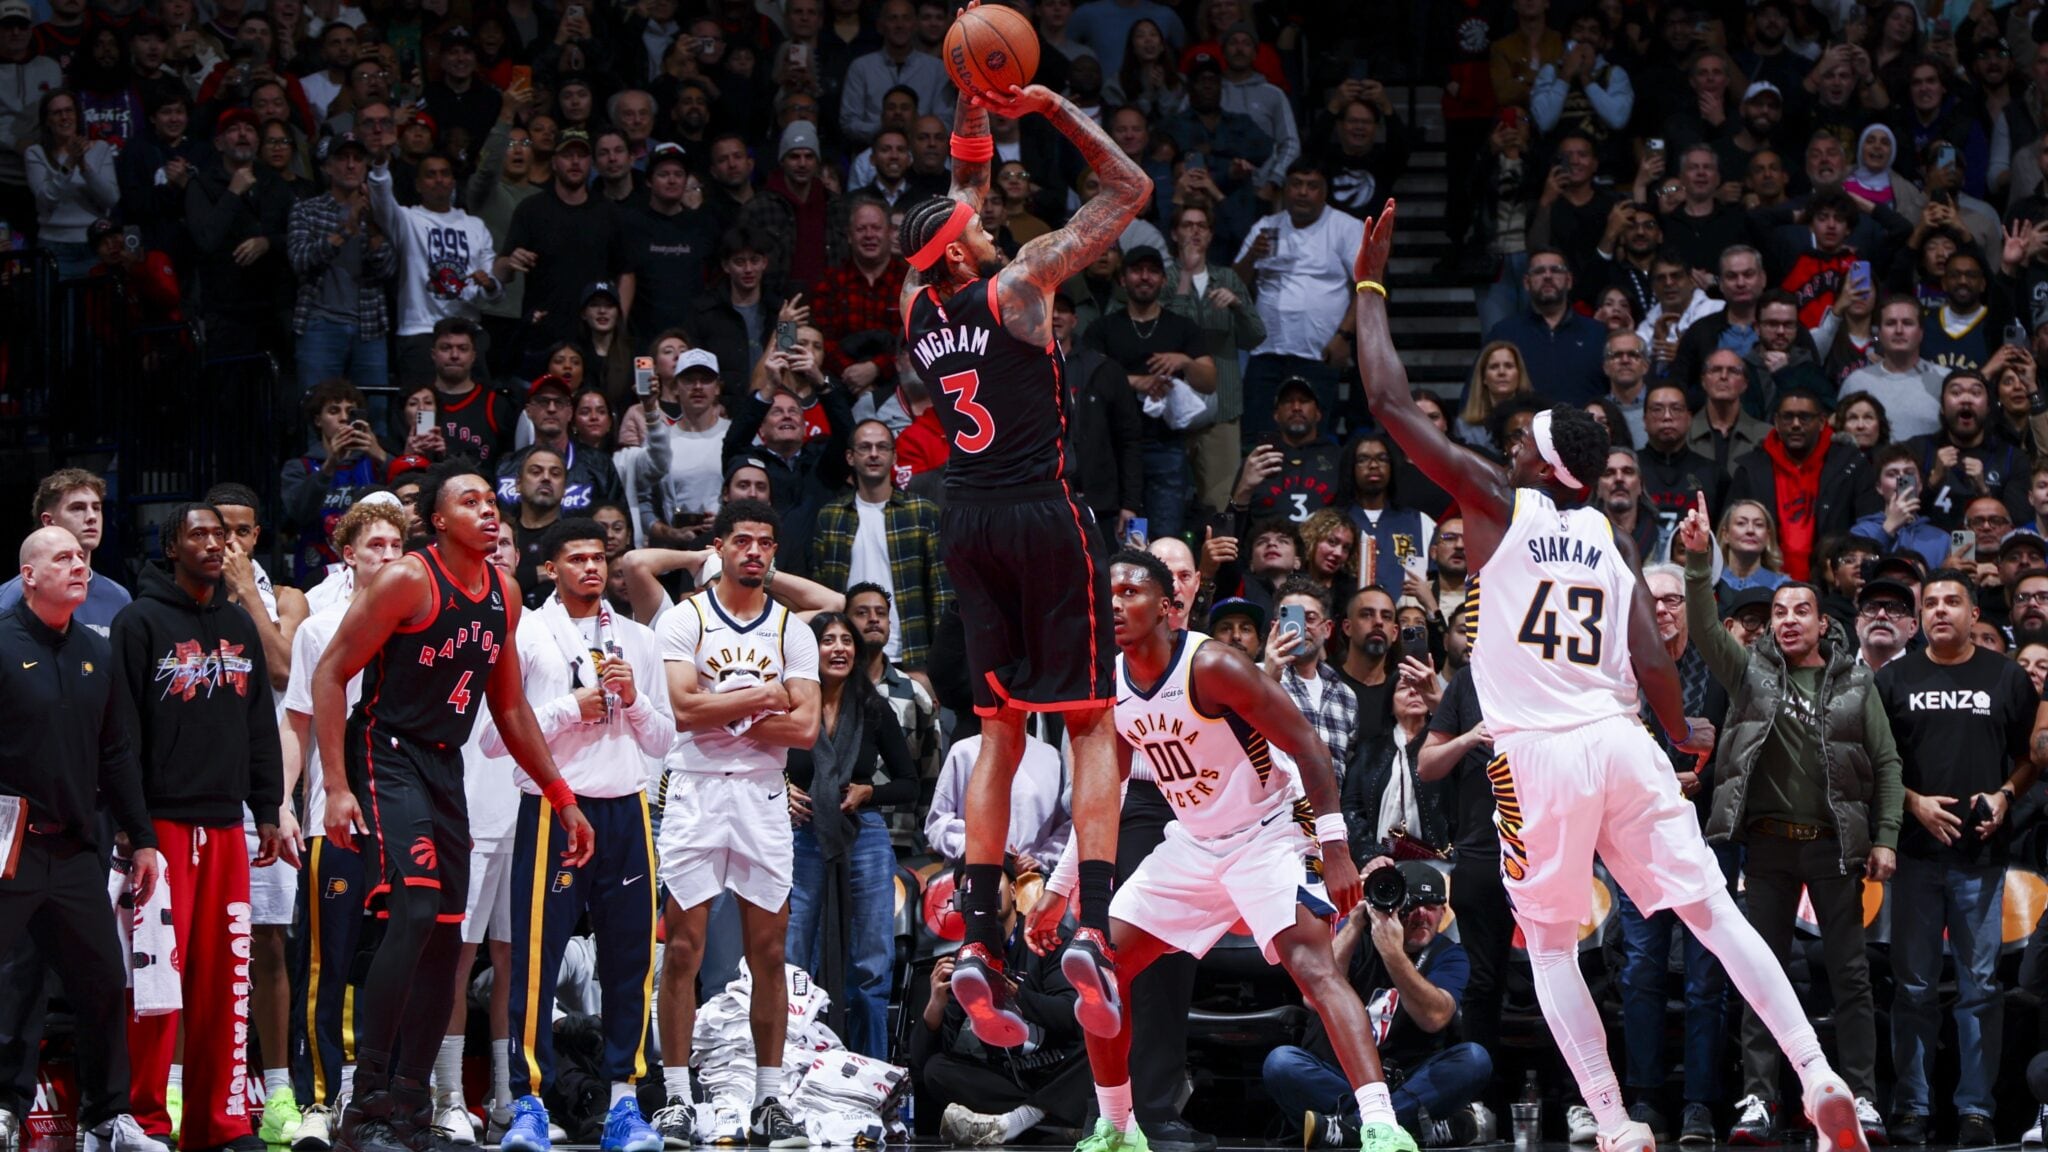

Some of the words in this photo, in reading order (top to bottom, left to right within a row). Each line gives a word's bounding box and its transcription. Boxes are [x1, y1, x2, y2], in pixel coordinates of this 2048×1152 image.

[951, 45, 985, 97] Wilso
[914, 325, 990, 370] INGRAM
[940, 369, 995, 454] 3
[1288, 494, 1308, 523] 3
[1934, 485, 1953, 514] 4
[1528, 537, 1602, 570] SIAKAM
[418, 621, 501, 667] RAPTOR
[1518, 581, 1603, 666] 43
[701, 647, 778, 682] INDIANA
[447, 671, 474, 714] 4
[1161, 690, 1176, 698] LUCAS
[1144, 740, 1197, 782] 00
[32, 1118, 75, 1133] MAGELLAN
